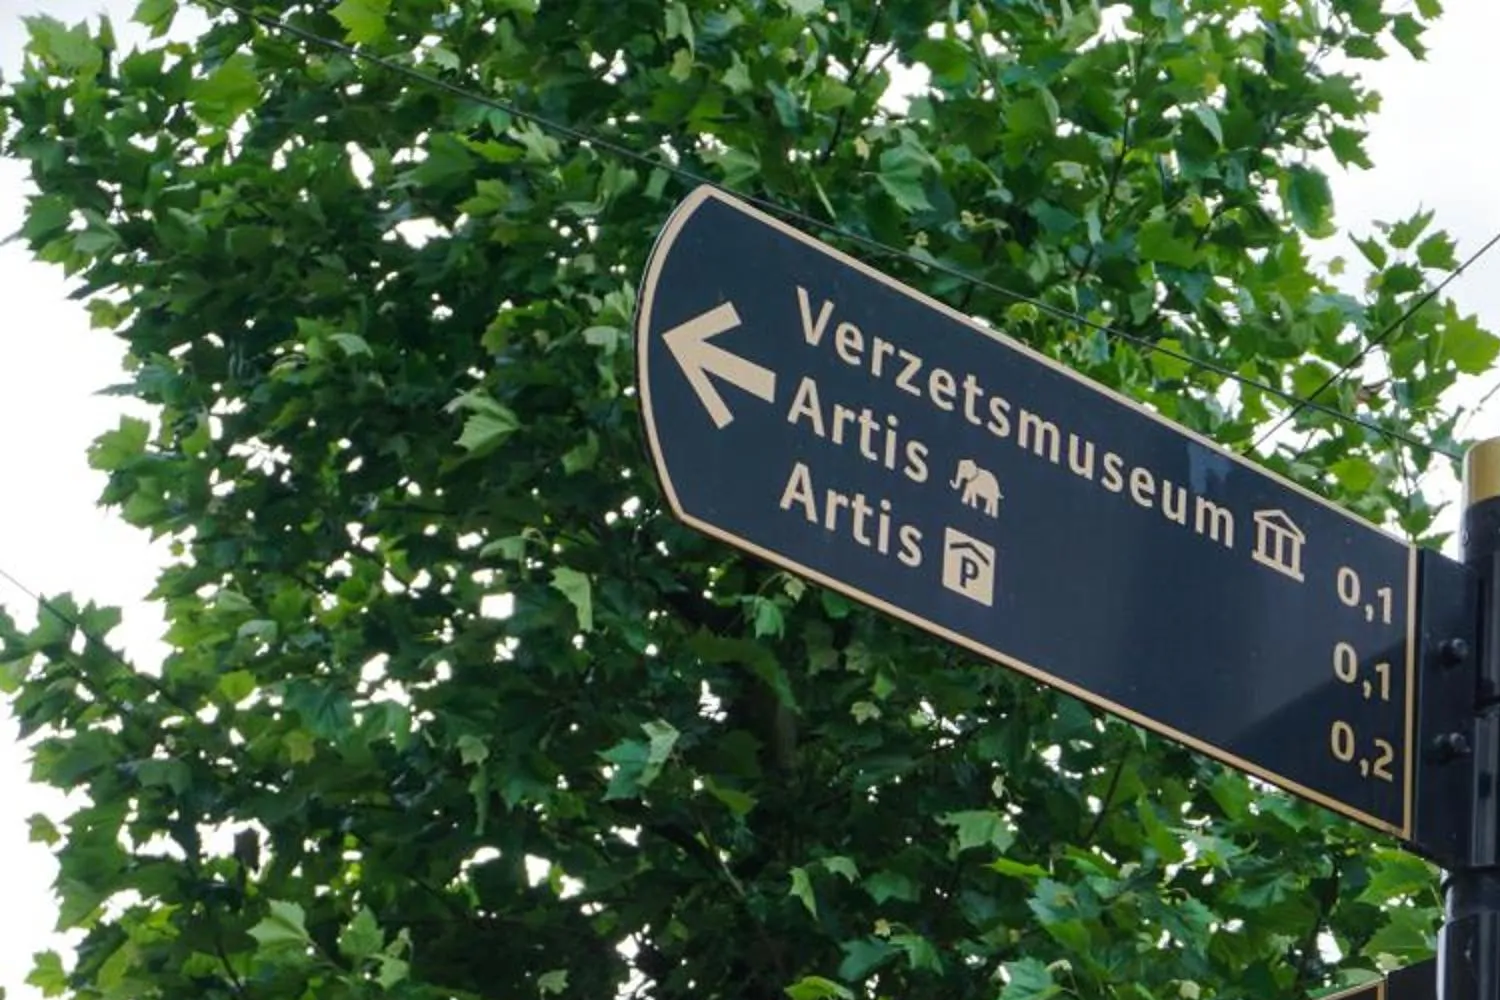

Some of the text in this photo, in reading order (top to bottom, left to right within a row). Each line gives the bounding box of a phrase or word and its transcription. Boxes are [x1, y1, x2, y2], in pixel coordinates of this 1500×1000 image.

[786, 375, 1390, 701] Artis 0,1
[796, 285, 1393, 625] Verzetsmuseum 0,1
[778, 461, 923, 568] Artis
[1330, 720, 1394, 781] 0,2
